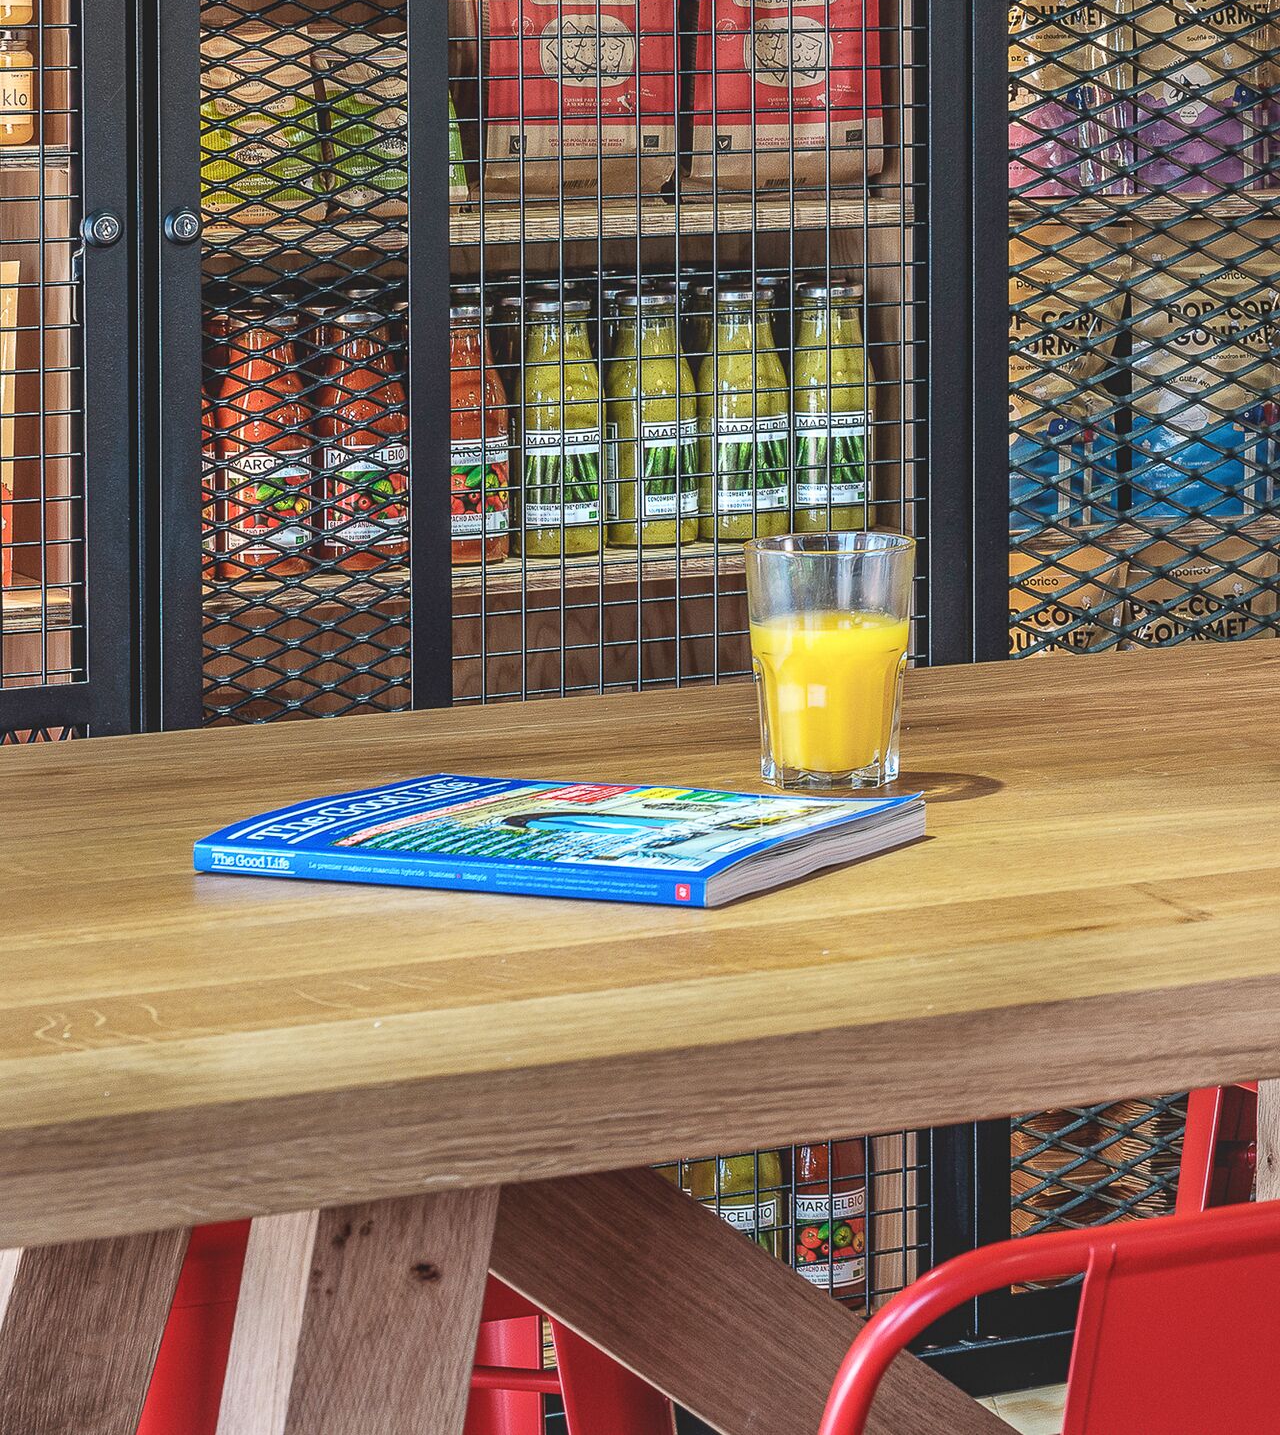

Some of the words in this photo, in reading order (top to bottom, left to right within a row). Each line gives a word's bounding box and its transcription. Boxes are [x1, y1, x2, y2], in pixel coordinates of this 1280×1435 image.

[247, 814, 328, 841] The
[318, 790, 415, 822] Good
[404, 778, 481, 806] Life
[212, 853, 234, 867] The
[235, 854, 267, 869] Good
[266, 855, 290, 870] Life
